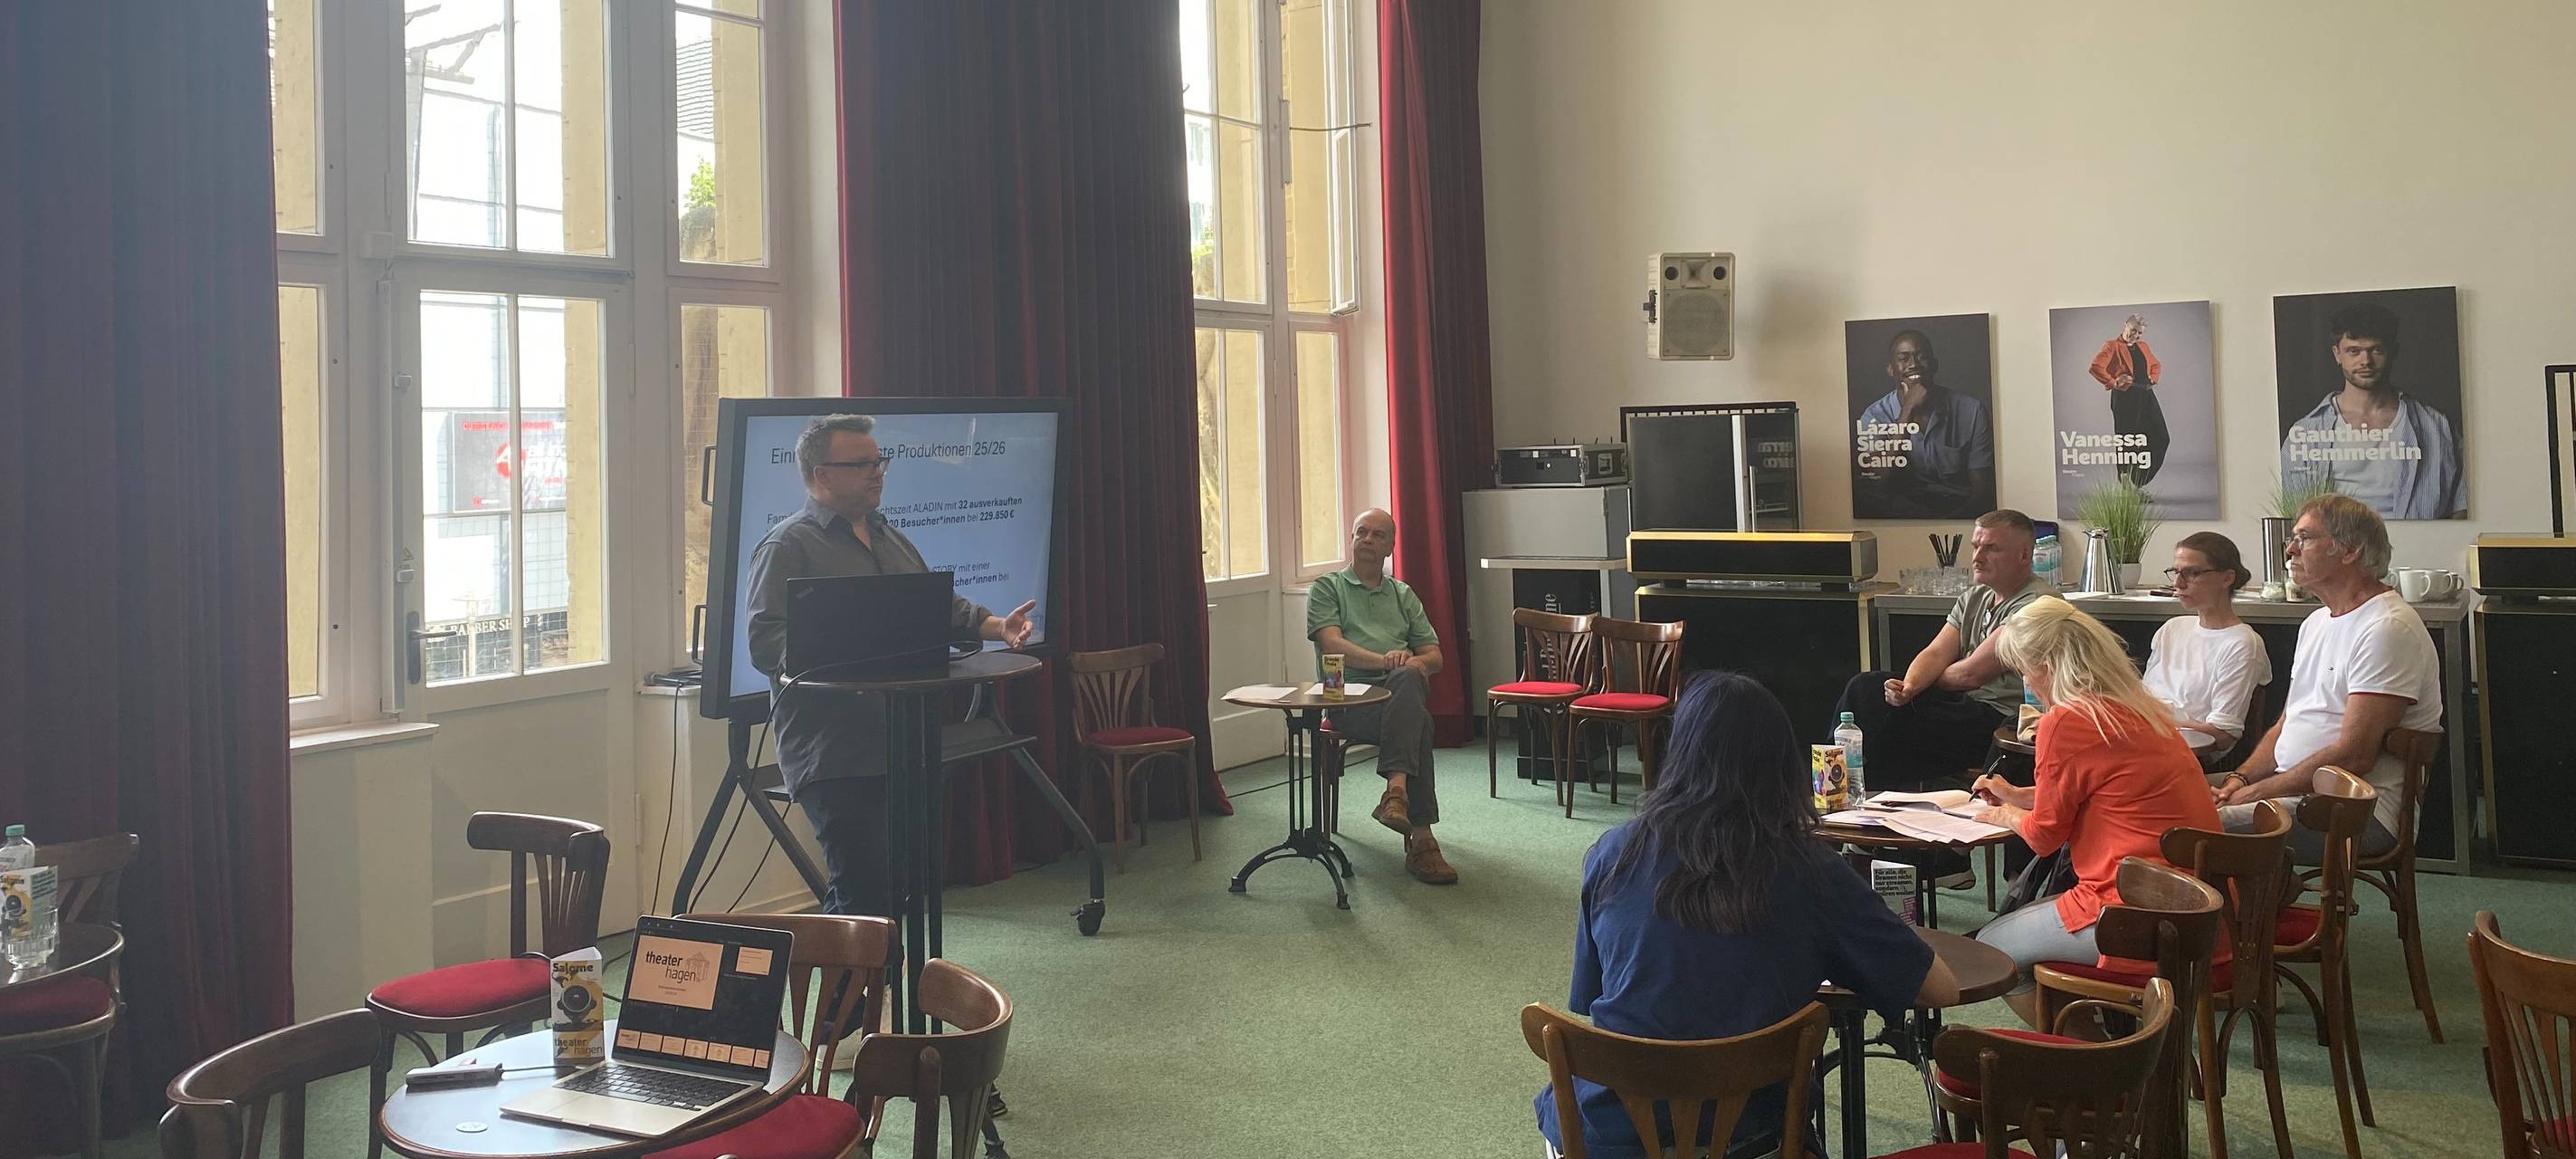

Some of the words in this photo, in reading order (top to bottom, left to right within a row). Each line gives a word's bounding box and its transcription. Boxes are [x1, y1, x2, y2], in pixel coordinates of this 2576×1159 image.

[1856, 418, 1920, 436] Lázaro
[2288, 423, 2392, 443] Gauthier
[1857, 436, 1913, 452] Sierra
[2059, 431, 2148, 447] Vanessa
[898, 443, 971, 458] Produktionen
[975, 441, 1006, 455] 25/26
[2289, 442, 2422, 462] Hemmerlin
[1857, 451, 1908, 468] Cairo
[2062, 447, 2151, 470] Henning
[913, 502, 943, 513] ALADIN
[944, 501, 957, 512] mit
[959, 500, 968, 510] 32
[969, 497, 1022, 509] ausverkauften
[968, 513, 978, 522] bei
[979, 511, 1008, 522] 229.850
[959, 563, 970, 572] mit
[972, 561, 990, 570] einer
[645, 951, 683, 967] theater
[553, 963, 594, 973] Salome
[664, 966, 696, 983] hagen
[555, 1039, 587, 1047] theater
[574, 1045, 603, 1057] hagen
